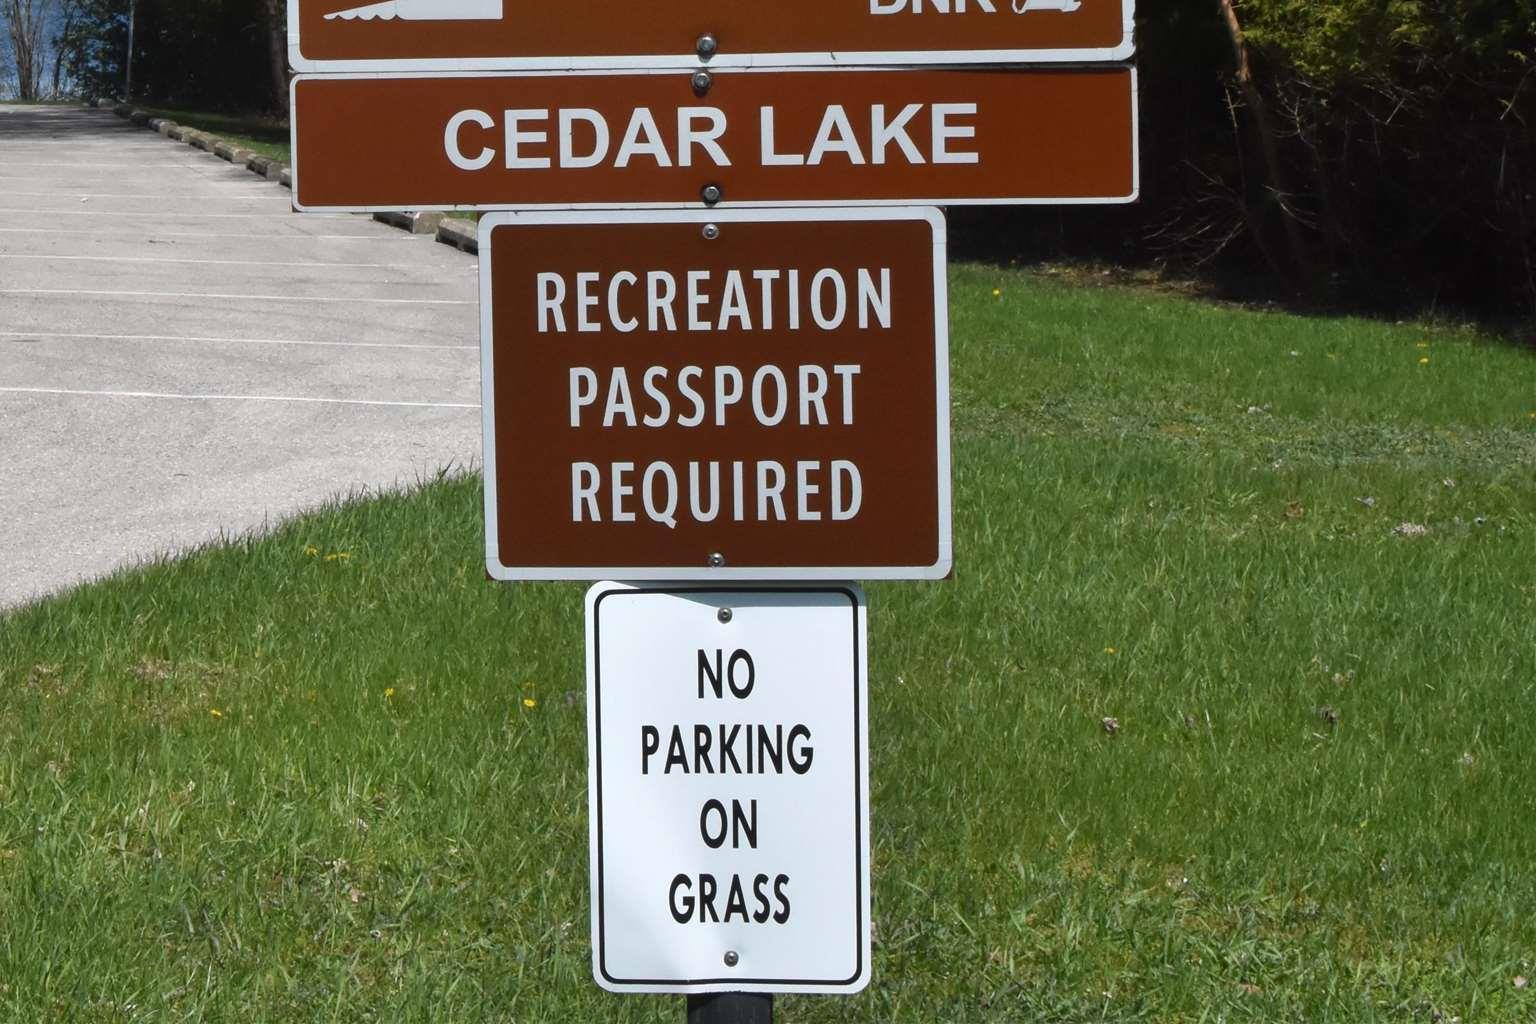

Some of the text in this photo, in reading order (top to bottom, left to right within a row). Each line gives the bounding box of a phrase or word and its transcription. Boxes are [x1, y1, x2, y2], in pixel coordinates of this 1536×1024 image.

[445, 103, 978, 170] CEDAR LAKE
[537, 268, 890, 332] RECREATION
[570, 365, 860, 427] PASSPORT
[572, 460, 862, 528] REQUIRED
[698, 649, 754, 699] NO
[642, 724, 813, 774] PARKING
[700, 799, 757, 848] ON
[669, 874, 790, 924] GRASS
